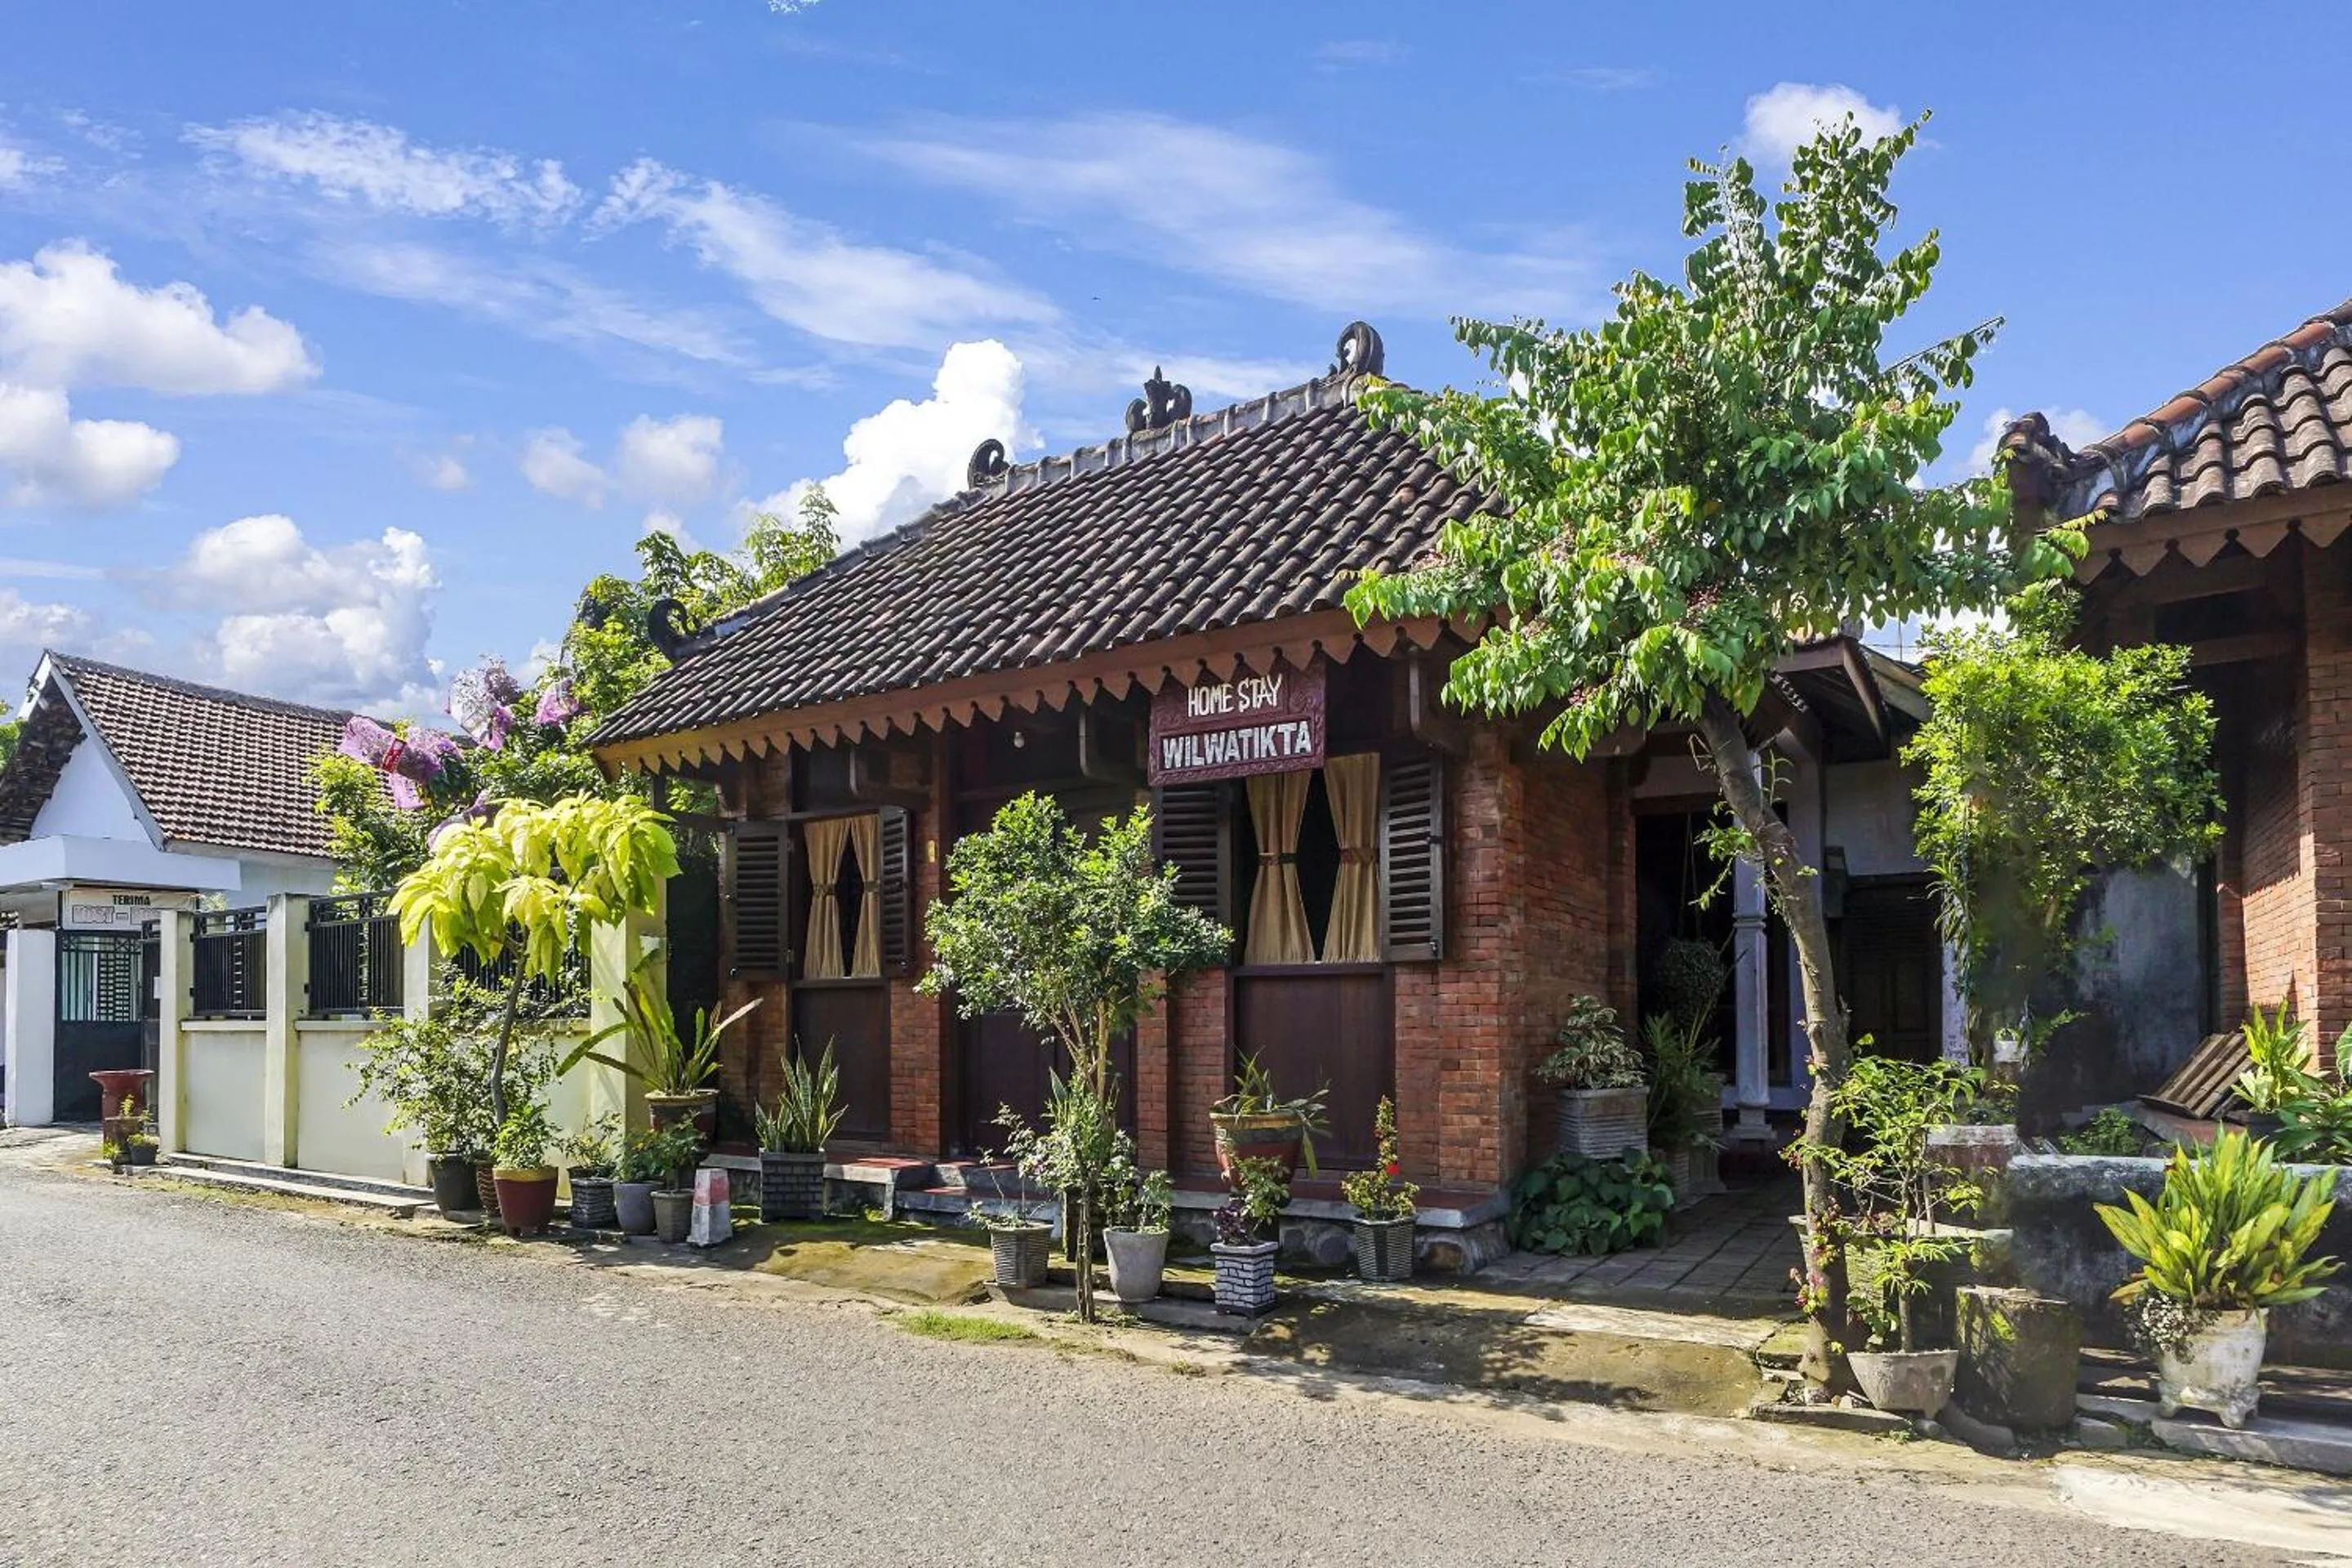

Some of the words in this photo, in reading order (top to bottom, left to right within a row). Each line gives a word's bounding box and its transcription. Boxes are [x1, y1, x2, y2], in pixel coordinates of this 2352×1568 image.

[1187, 684, 1234, 716] HOME
[1238, 674, 1281, 712] STAY
[1163, 721, 1311, 768] WILWATIKTA
[113, 895, 150, 905] TERIMA
